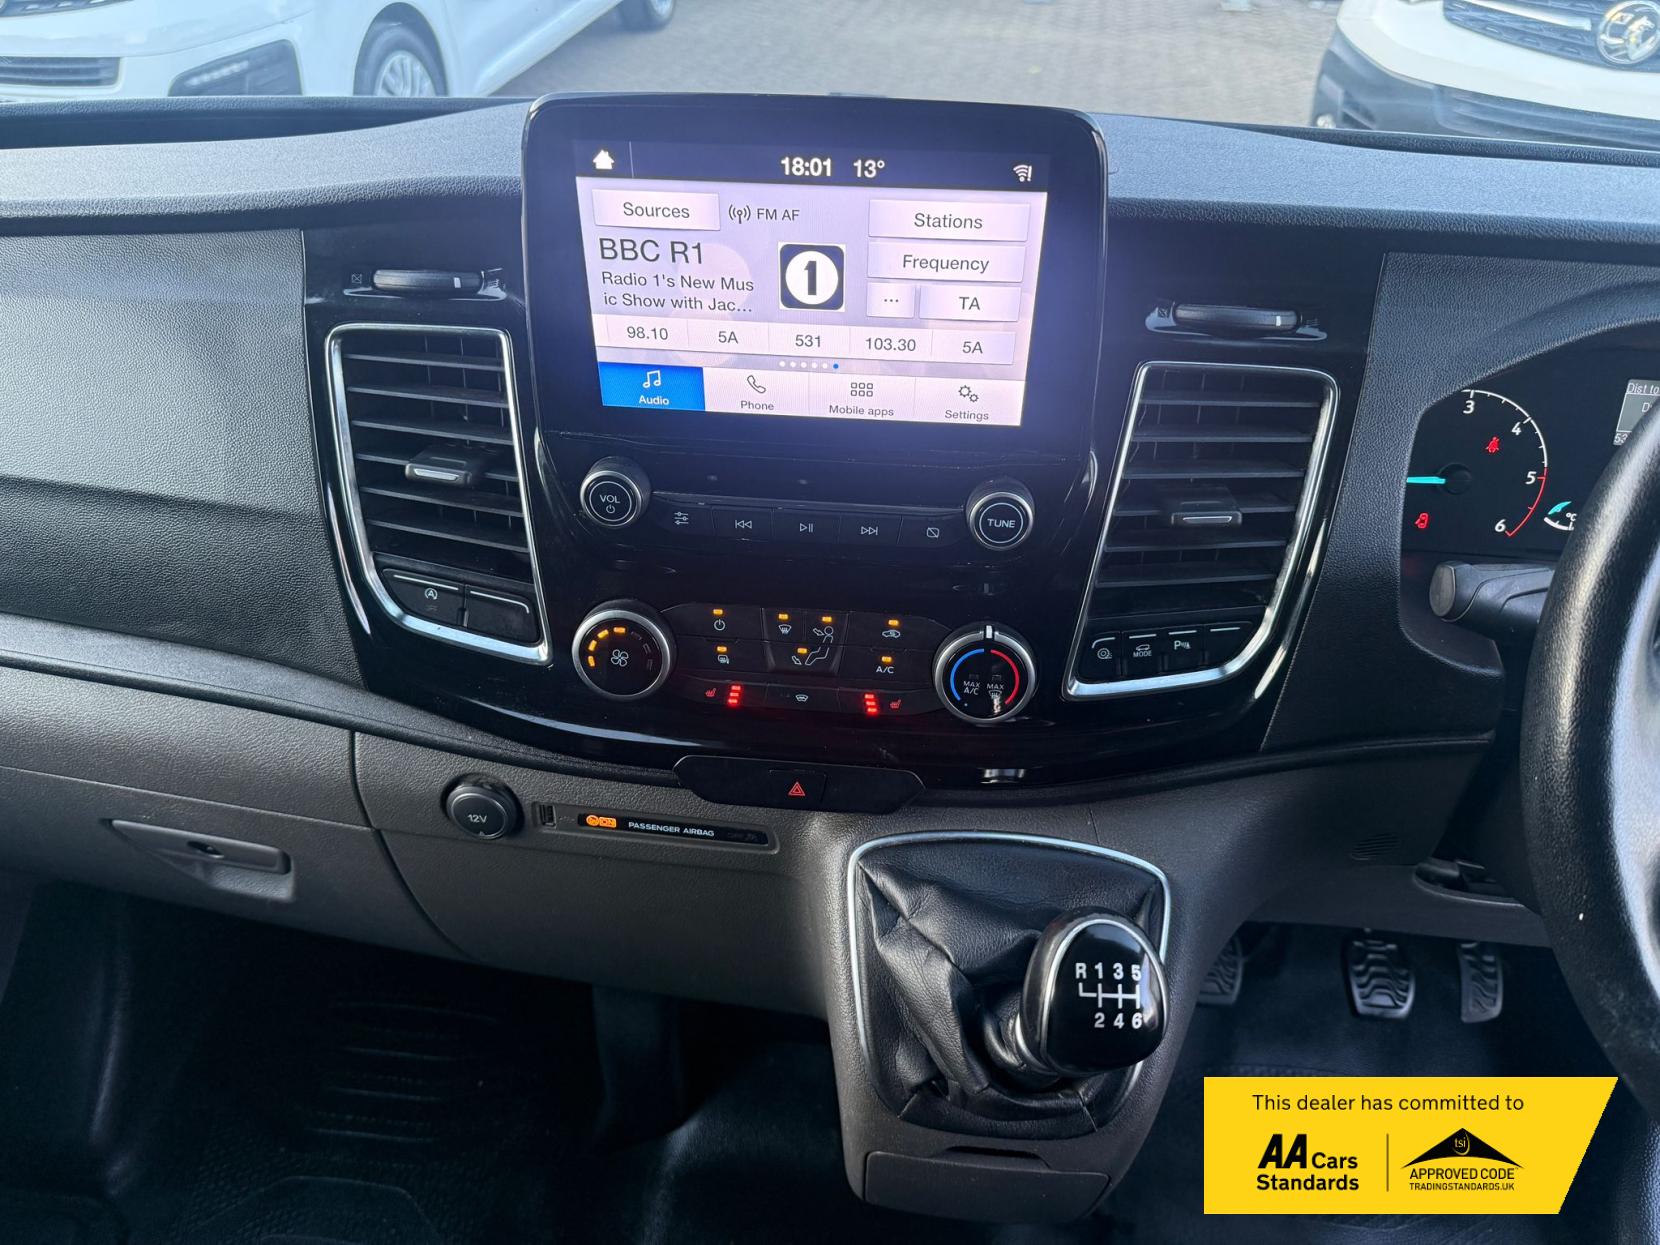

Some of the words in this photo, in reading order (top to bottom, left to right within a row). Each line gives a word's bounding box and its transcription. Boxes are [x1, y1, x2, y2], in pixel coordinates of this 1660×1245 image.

[781, 157, 832, 177] 18:01
[853, 159, 886, 179] 13°
[622, 202, 690, 219] Sources
[757, 208, 778, 221] FM
[781, 209, 800, 222] AF
[914, 212, 983, 230] Stations
[599, 237, 661, 263] BBC
[670, 240, 703, 265] R1
[902, 254, 990, 274] Frequency
[602, 271, 648, 287] Radio
[653, 273, 676, 288] 1's
[680, 275, 716, 289] New
[720, 276, 754, 291] Mus
[803, 260, 818, 296] 1
[604, 292, 617, 306] ic
[622, 293, 666, 308] Show
[670, 295, 704, 310] with
[708, 297, 752, 313] Jac...
[959, 296, 981, 311] TA
[626, 326, 669, 341] 98.10
[718, 330, 739, 345] 5A
[795, 334, 822, 348] 531
[865, 337, 917, 352] 103.30
[962, 341, 984, 354] 5A
[1626, 382, 1648, 394] Dist
[638, 394, 670, 406] Audio
[740, 400, 775, 411] Phone
[1462, 400, 1476, 414] 3
[829, 404, 865, 416] Mobile
[867, 406, 894, 418] apps
[945, 409, 990, 421] Settings
[1511, 421, 1523, 436] 4
[1525, 470, 1537, 485] 5
[599, 494, 621, 504] VOL
[987, 518, 1016, 528] TUNE
[1494, 518, 1506, 532] 6
[1133, 650, 1152, 658] MODE
[875, 665, 895, 674] A/C
[963, 680, 981, 688] MAX
[963, 686, 979, 696] A/C
[467, 813, 488, 823] 12V
[628, 821, 681, 833] PASSENGER
[683, 827, 715, 837] AIRBAG
[1075, 962, 1087, 979] R
[1094, 962, 1104, 979] 1
[1112, 963, 1124, 980] 3
[1131, 964, 1142, 982] 5
[1094, 1012, 1105, 1028] 2
[1113, 1013, 1125, 1029] 4
[1131, 1012, 1143, 1029] 6
